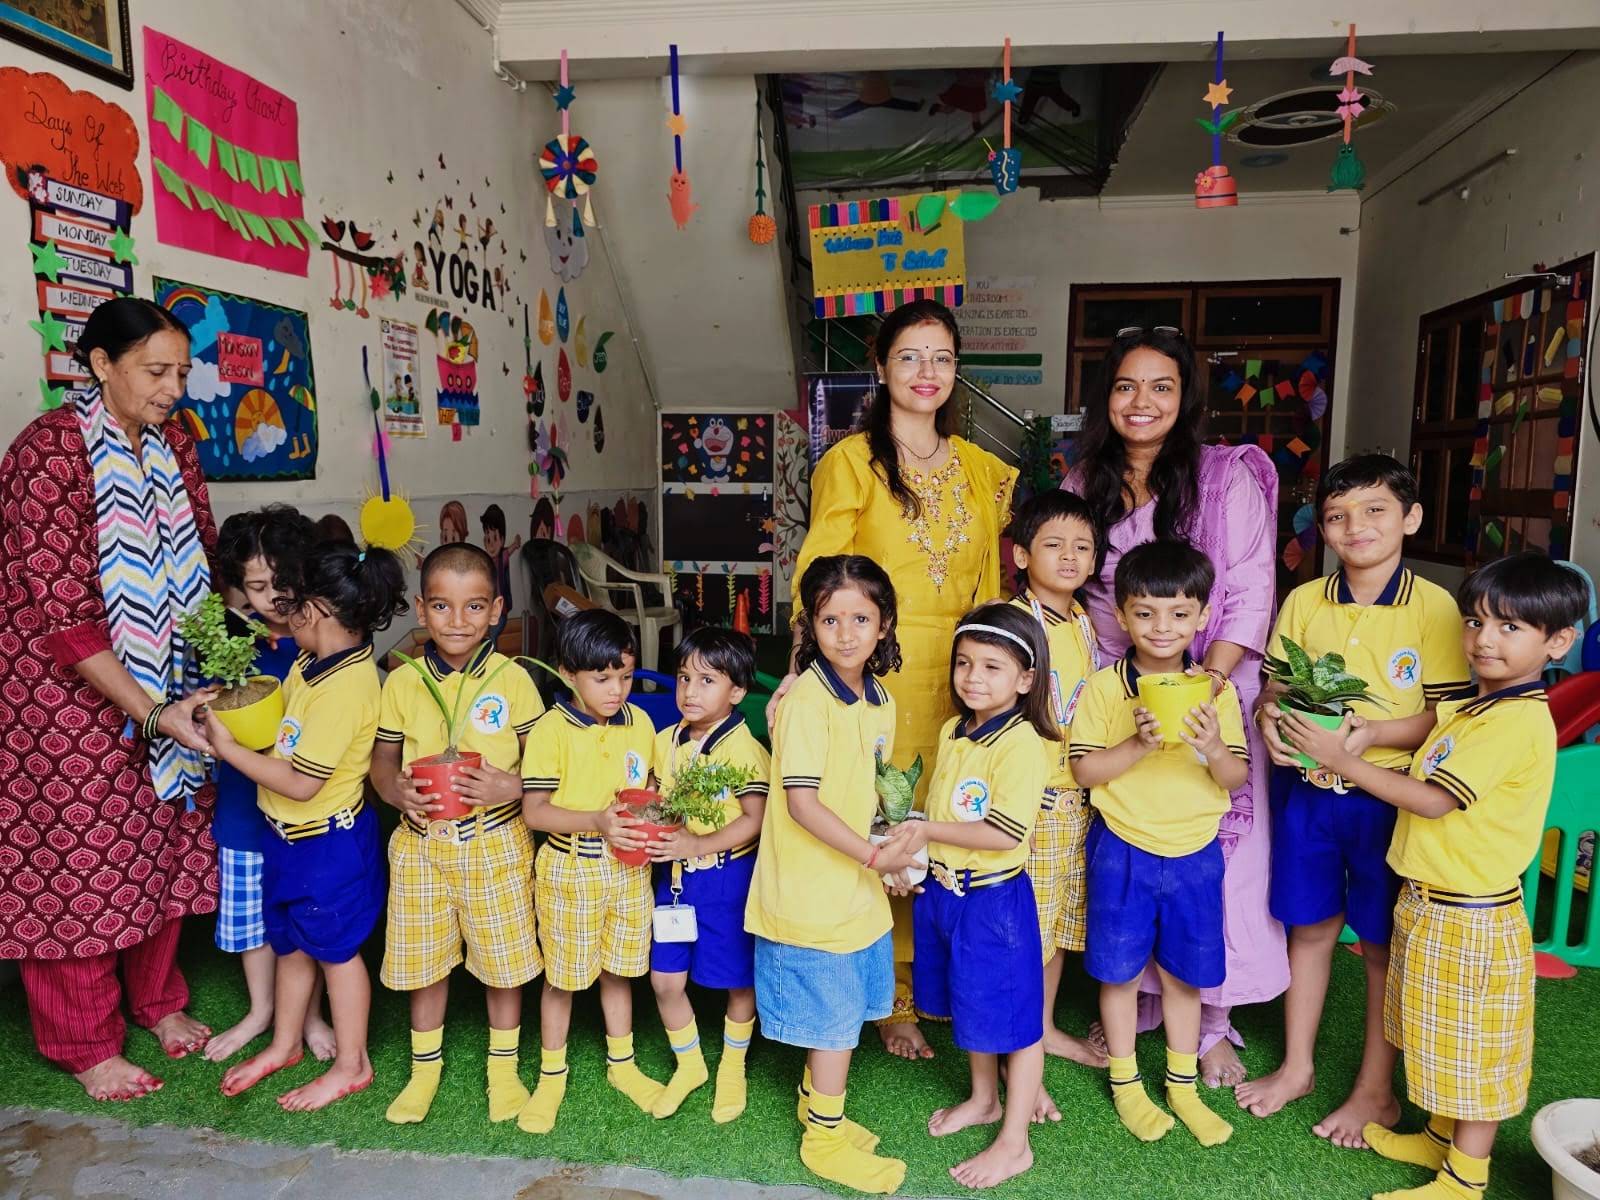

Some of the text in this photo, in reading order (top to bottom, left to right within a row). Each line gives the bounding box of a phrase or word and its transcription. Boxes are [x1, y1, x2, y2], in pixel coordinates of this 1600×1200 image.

[162, 40, 287, 126] Birthday Chart
[24, 91, 73, 151] Days
[63, 147, 89, 187] The
[56, 186, 103, 211] SUNDAY
[58, 223, 108, 247] MONDAY
[62, 255, 112, 280] TUESDAY
[428, 247, 497, 312] YOGA
